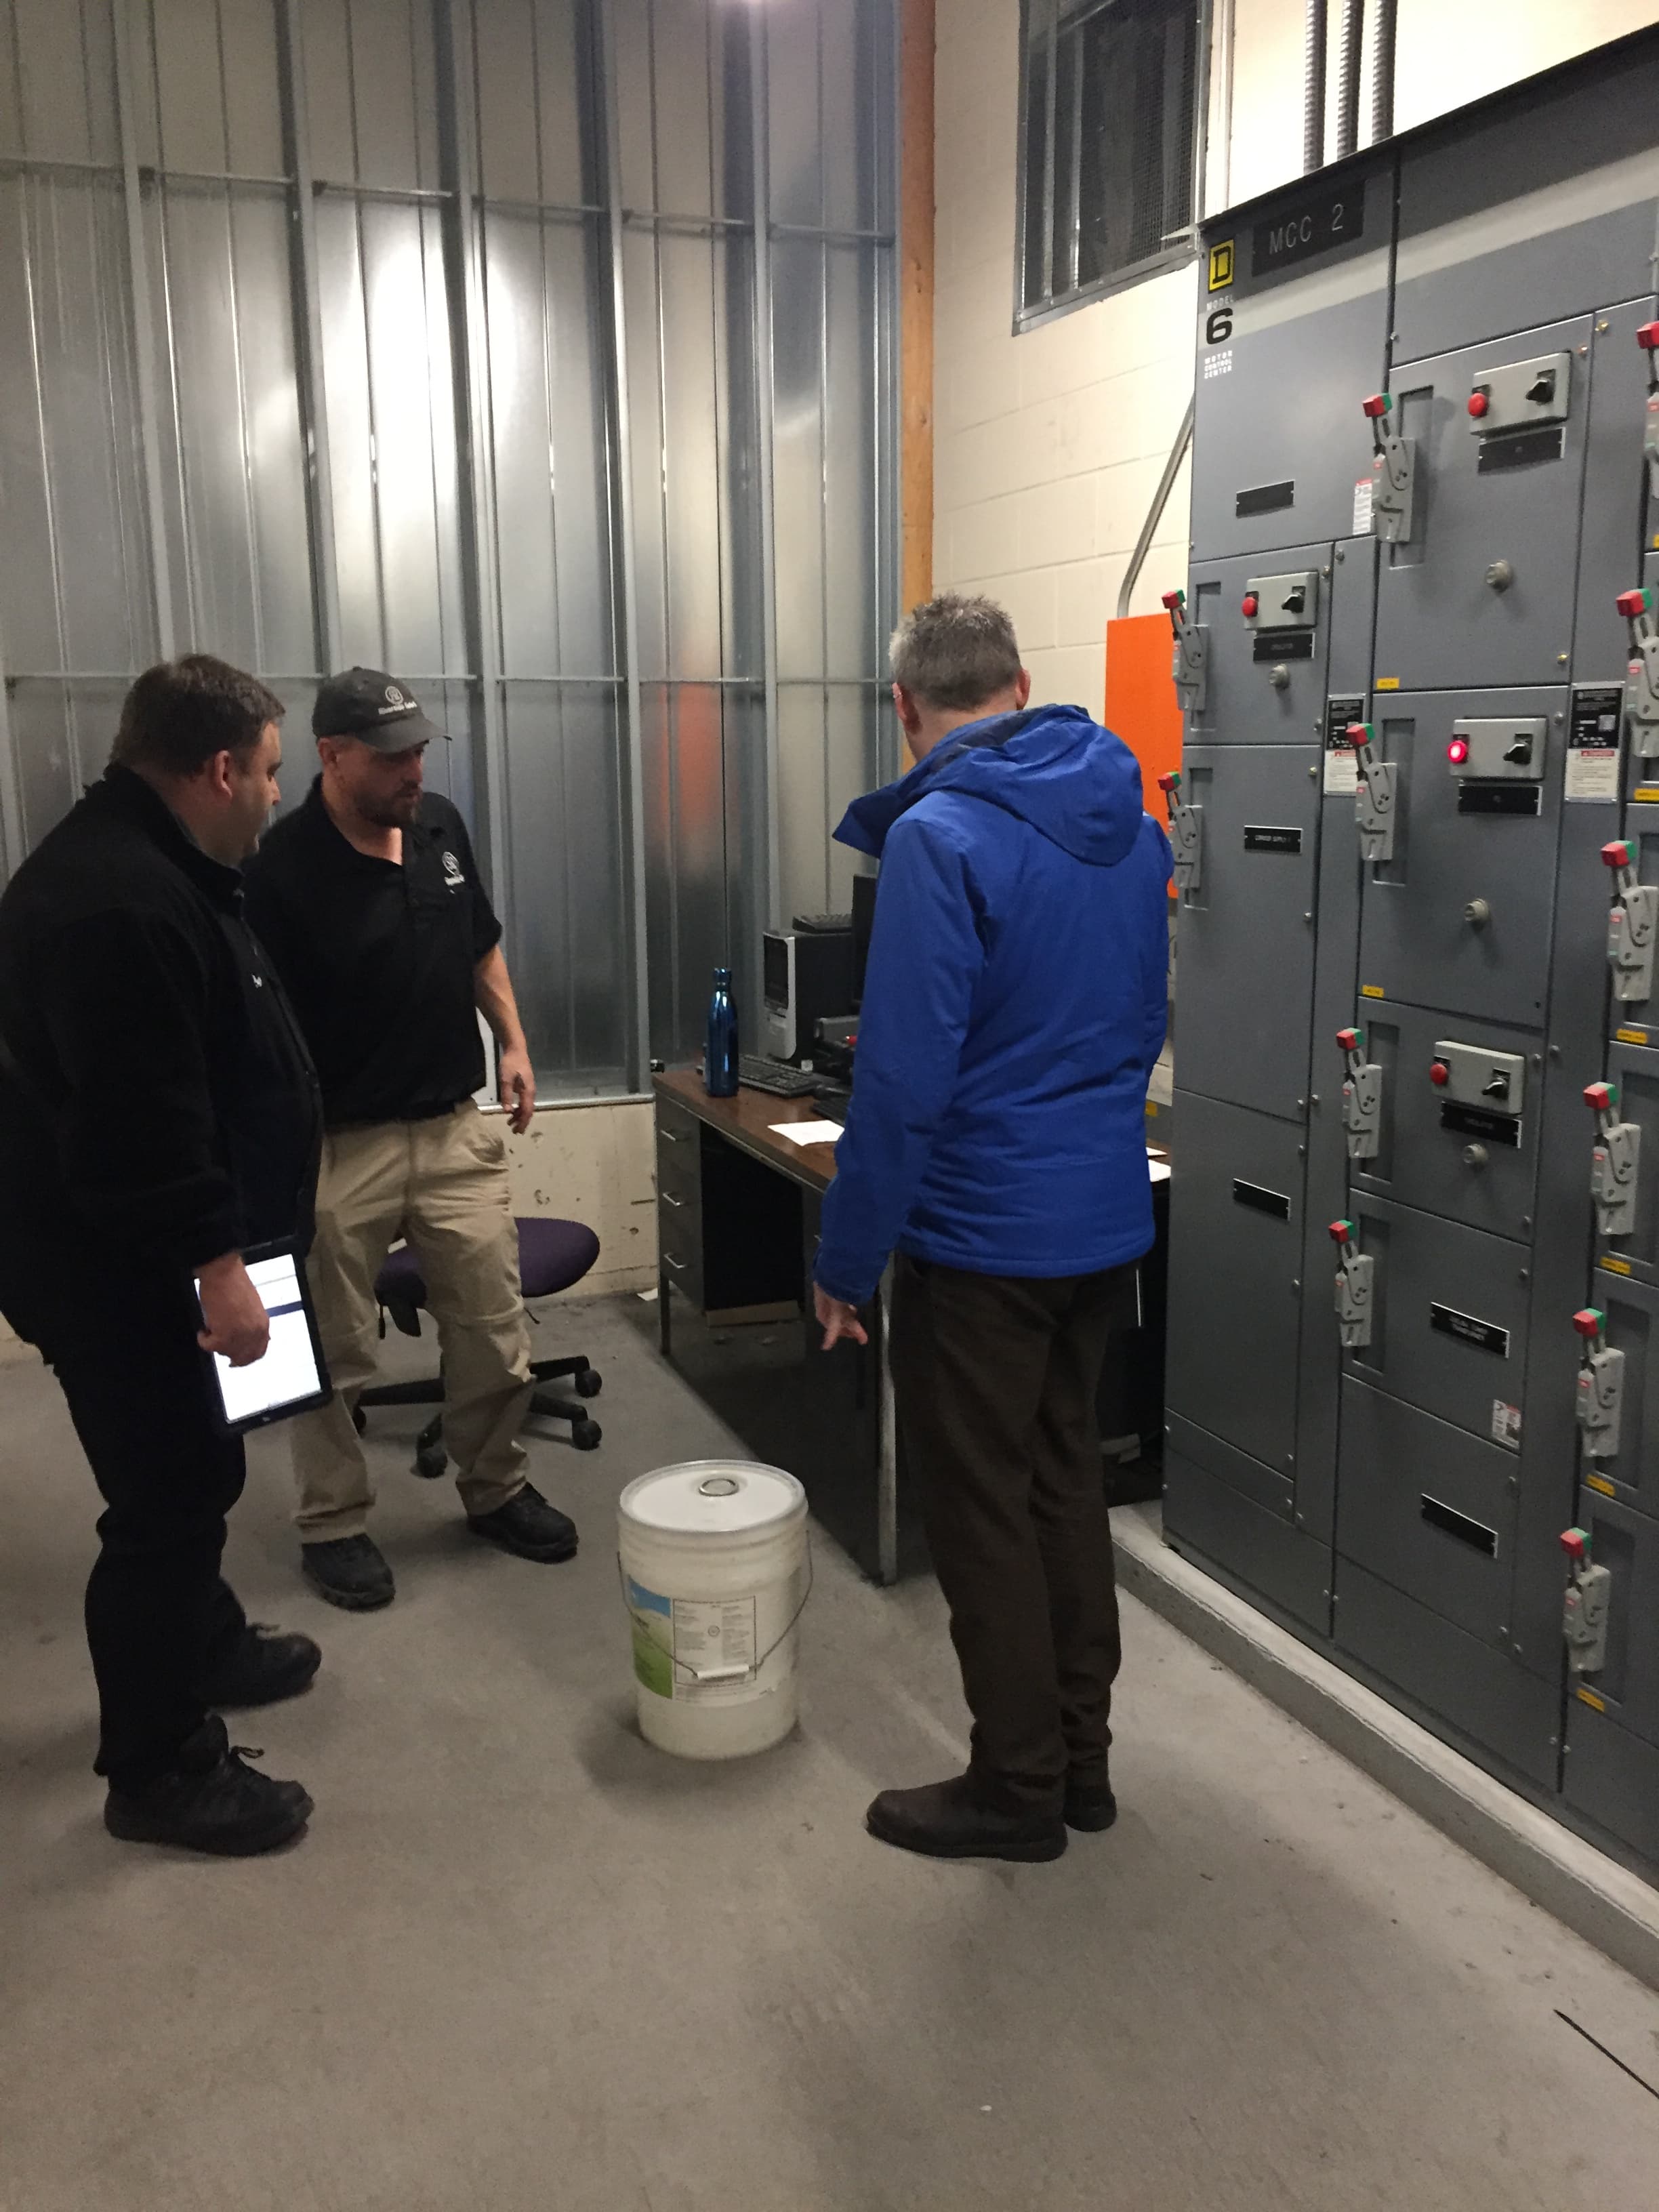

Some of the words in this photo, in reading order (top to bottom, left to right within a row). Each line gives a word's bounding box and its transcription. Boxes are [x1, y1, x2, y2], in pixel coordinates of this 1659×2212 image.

[1269, 215, 1312, 255] MCC
[1332, 203, 1344, 231] 2
[1206, 308, 1233, 344] 6
